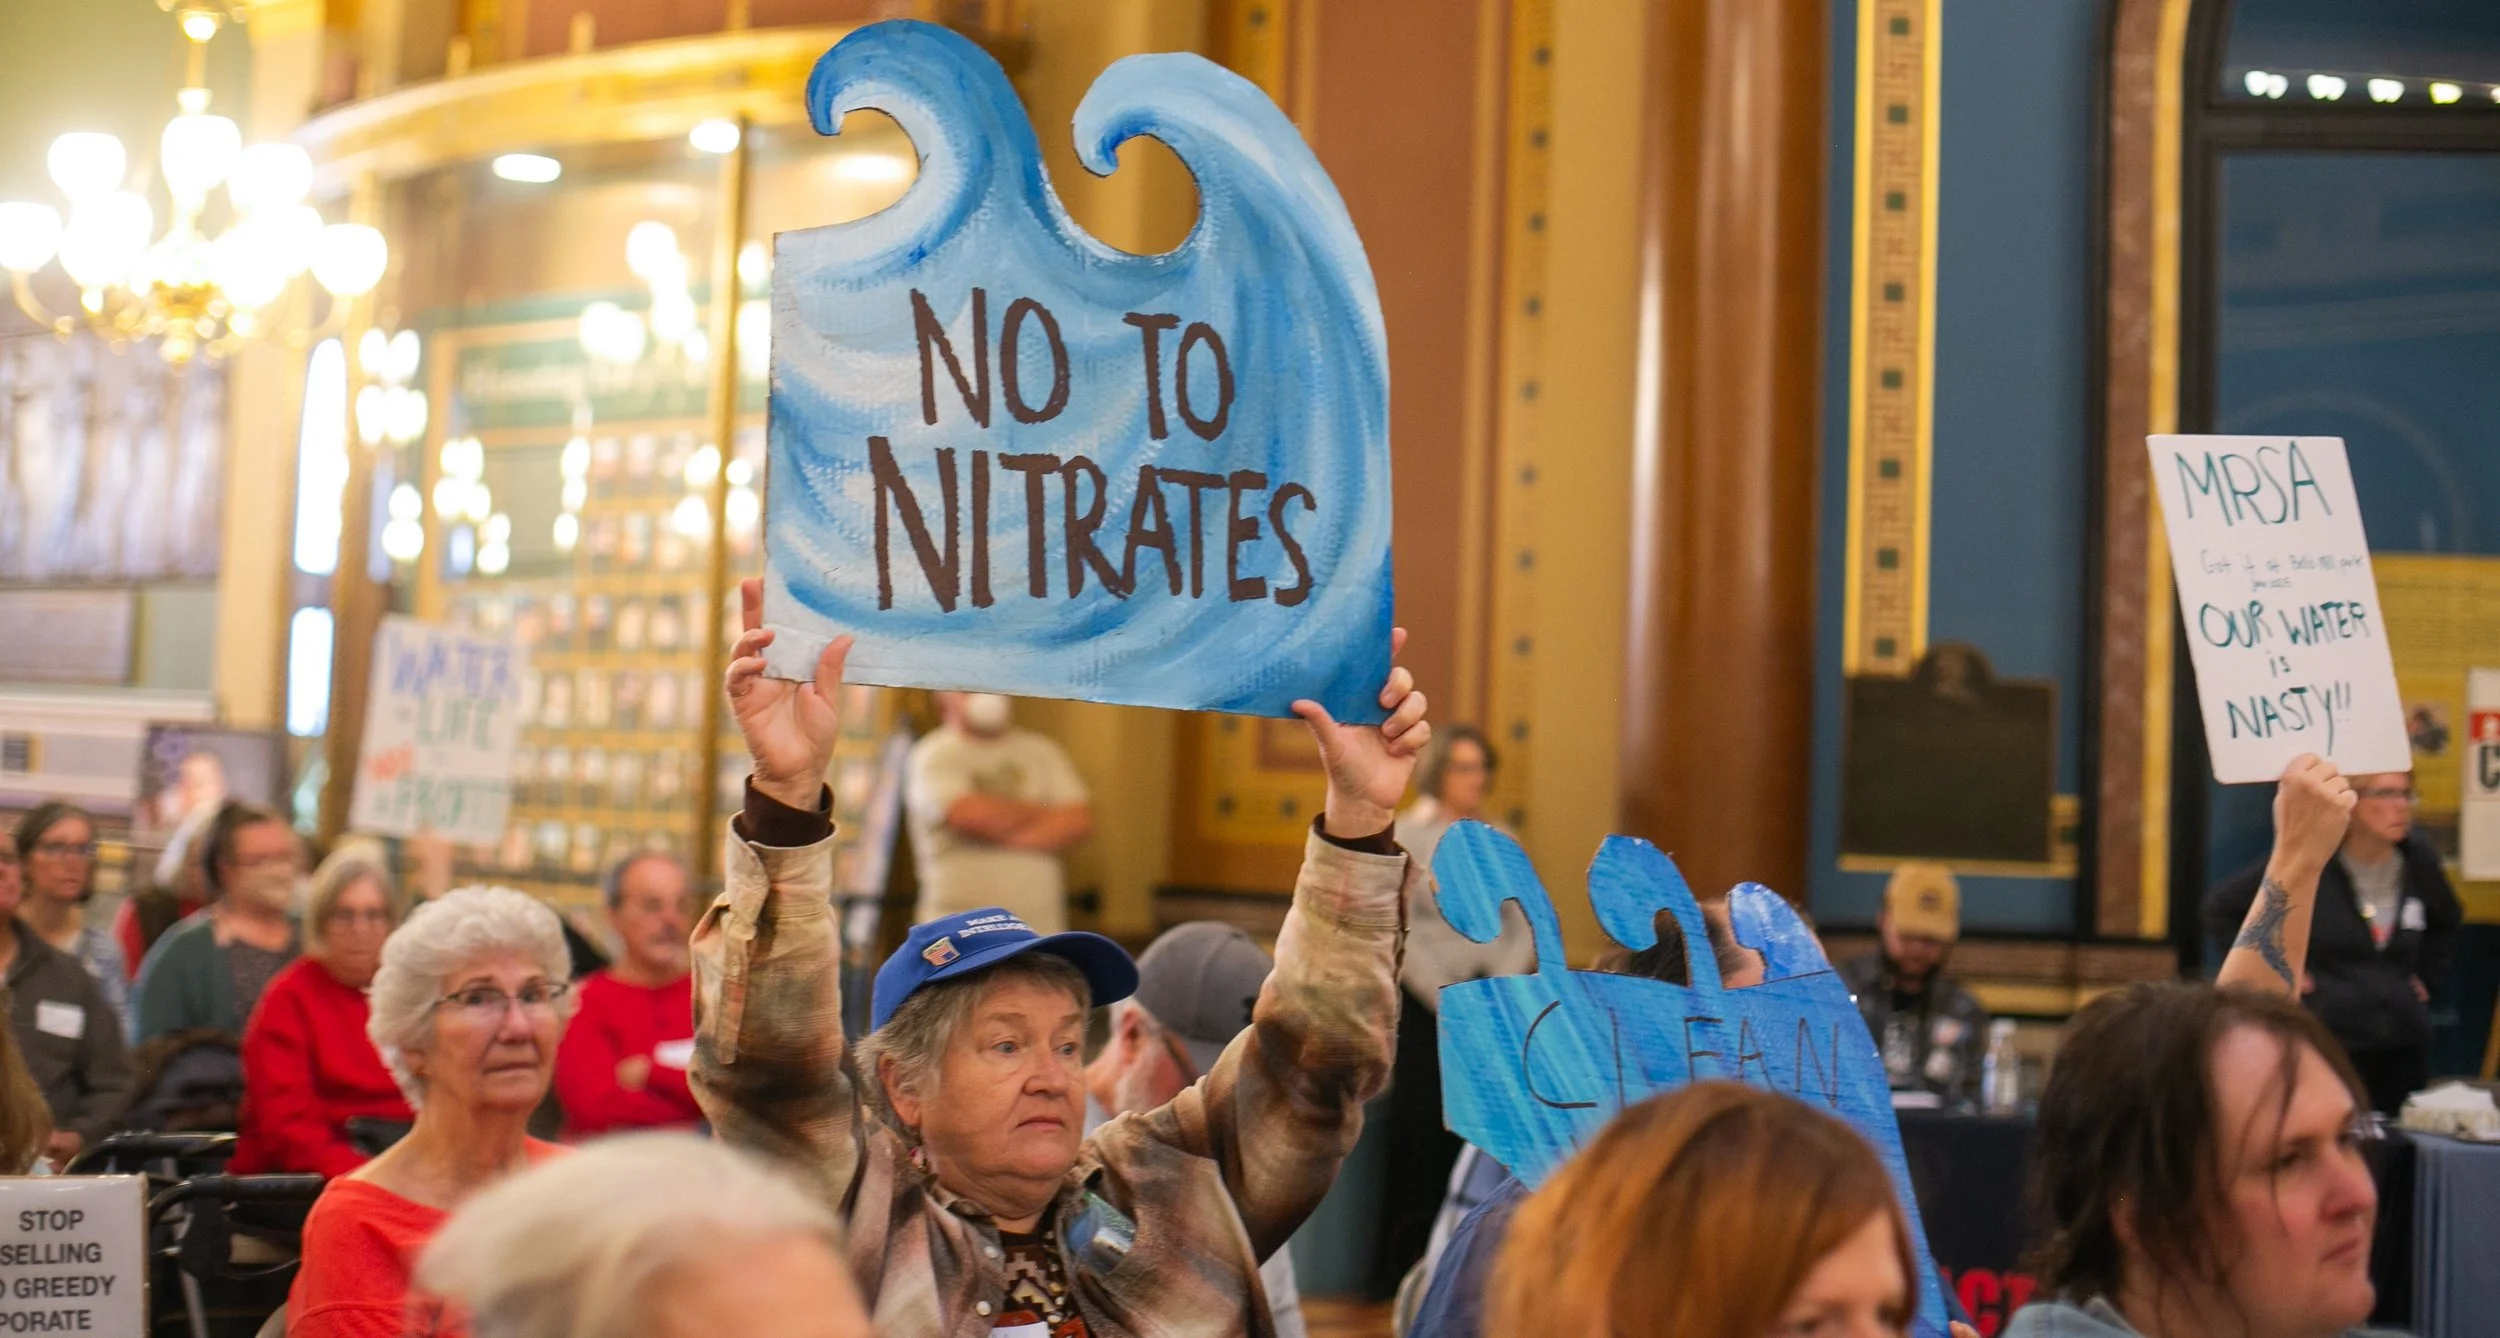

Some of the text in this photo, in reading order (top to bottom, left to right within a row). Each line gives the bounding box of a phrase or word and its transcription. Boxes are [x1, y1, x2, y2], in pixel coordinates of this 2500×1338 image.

[910, 286, 1235, 441] NO TO
[2174, 440, 2333, 526] MRSA
[867, 435, 1317, 613] NITRATES
[2199, 600, 2275, 648] OUR
[2278, 600, 2371, 646] WATER
[2265, 649, 2291, 678] is
[19, 1210, 84, 1231] STOP
[0, 1242, 102, 1266] SELLING
[13, 1275, 117, 1299] GREEDY
